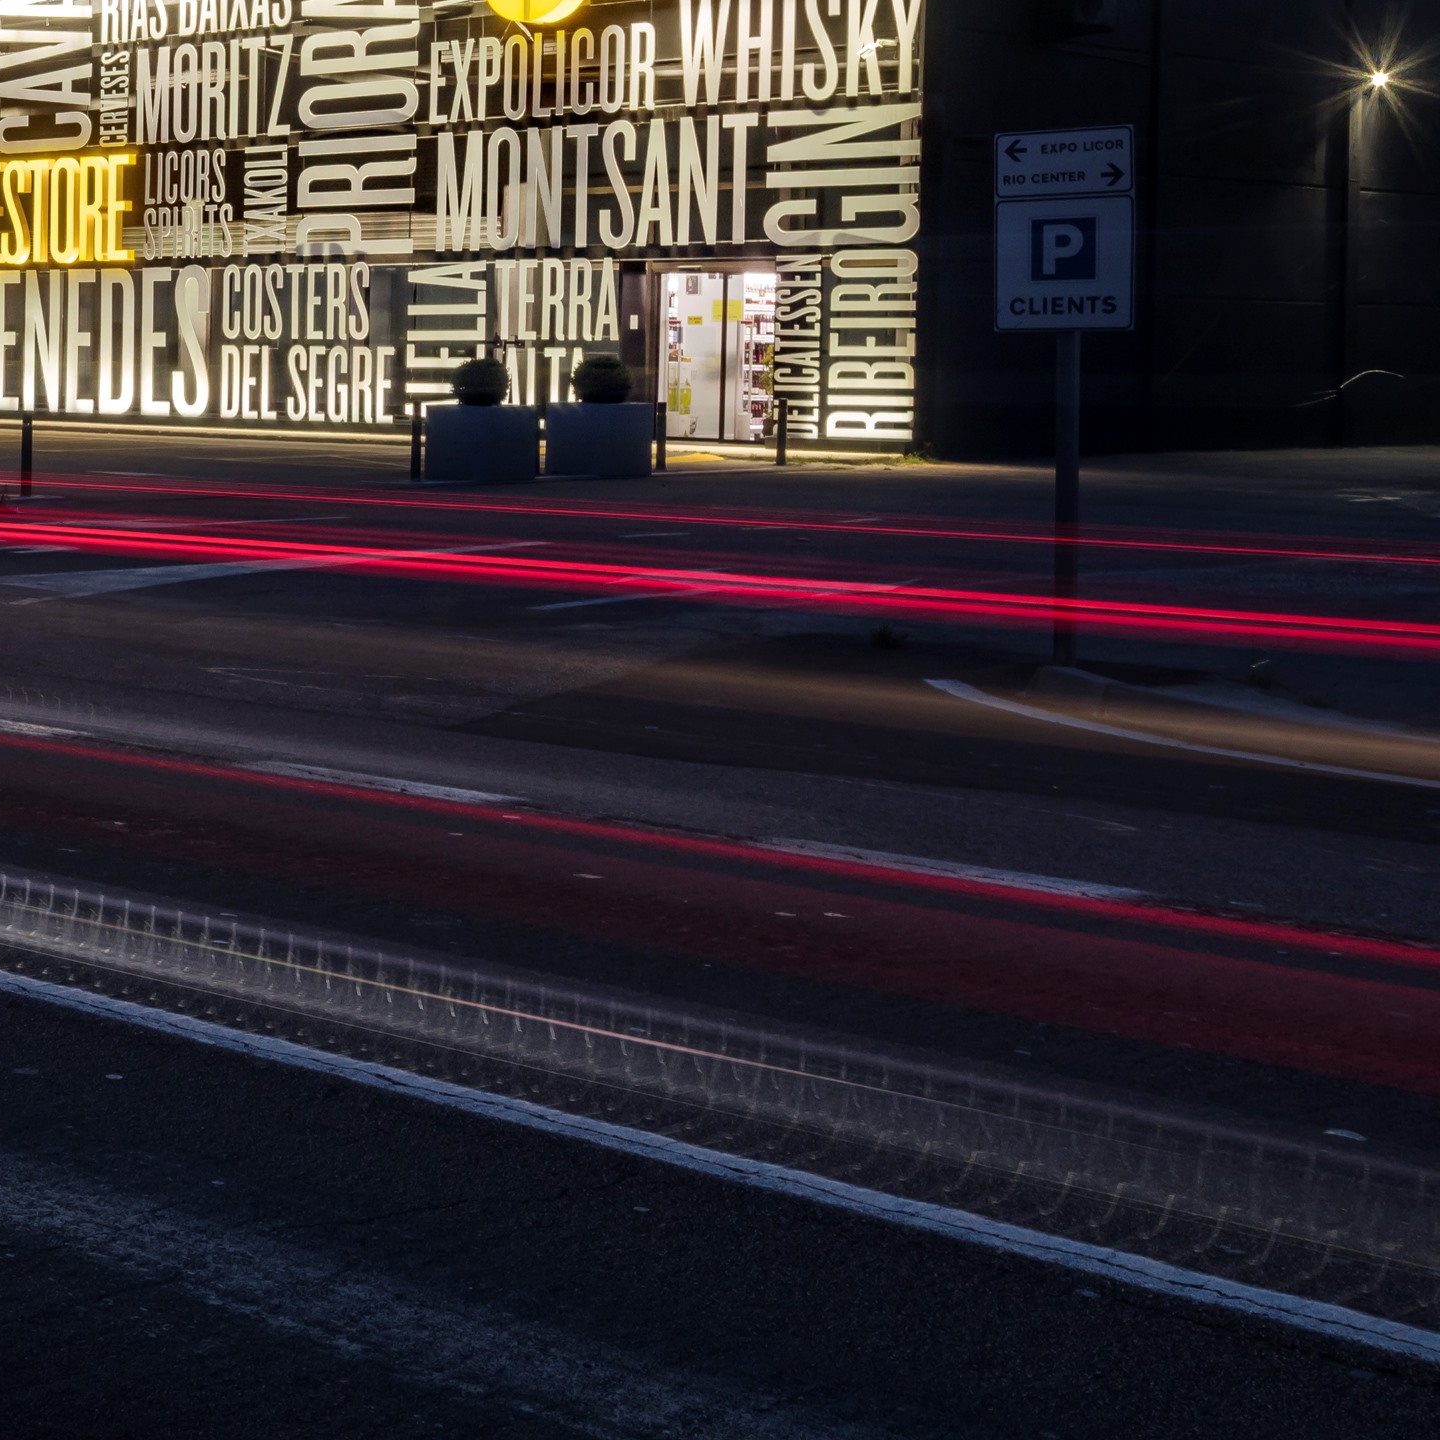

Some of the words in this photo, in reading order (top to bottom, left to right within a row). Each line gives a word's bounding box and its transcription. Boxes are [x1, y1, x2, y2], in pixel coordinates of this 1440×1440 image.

[99, 50, 130, 148] CERVESES
[136, 34, 294, 146] MORITZ
[429, 21, 656, 124] EXPOLICOR
[144, 148, 226, 205] LICORS
[436, 112, 759, 251] MONTSANT
[763, 102, 921, 247] GIN
[1003, 174, 1025, 185] RIO
[1031, 171, 1085, 184] CENTER
[1041, 142, 1077, 154] EXPO
[1083, 140, 1124, 152] LICOR
[143, 203, 233, 261] SPIRITS
[243, 144, 288, 257] TXAKOLI
[1043, 224, 1084, 275] P
[222, 261, 370, 341] COSTERS
[495, 257, 619, 341] TERRA
[1010, 295, 1117, 316] CLIENTS
[221, 345, 276, 421] DEL
[287, 345, 395, 423] SEGRE
[773, 254, 822, 440] DELICATESSEN
[826, 248, 918, 440] RIBEIRO
